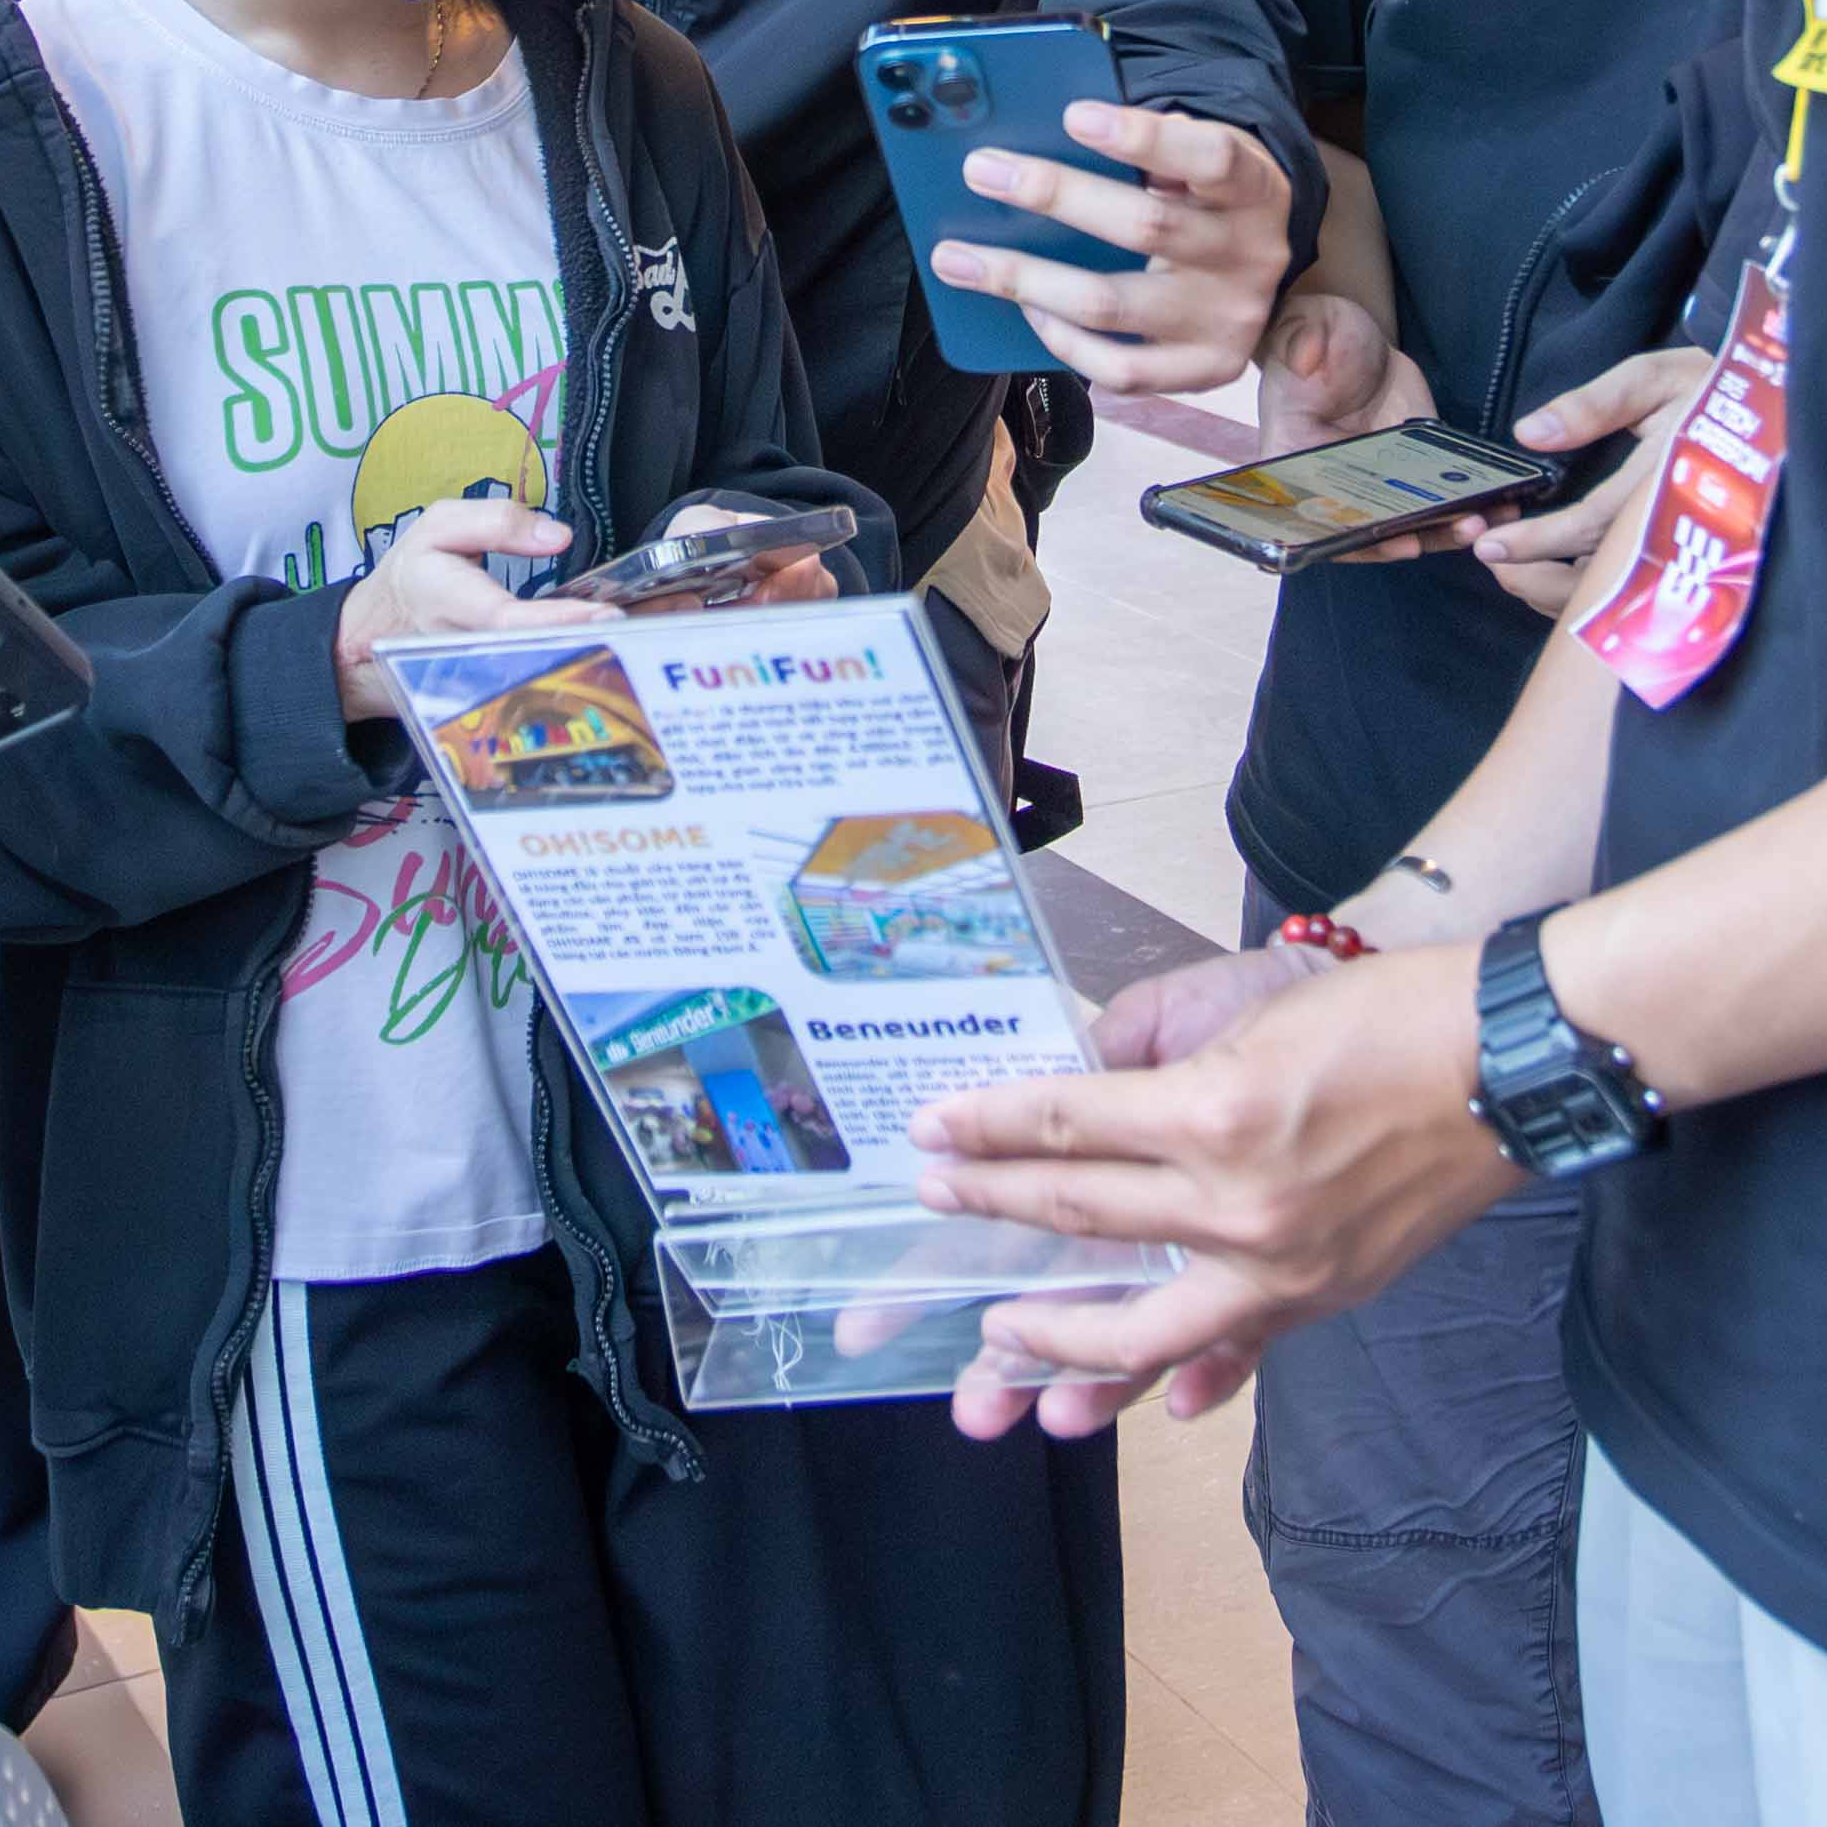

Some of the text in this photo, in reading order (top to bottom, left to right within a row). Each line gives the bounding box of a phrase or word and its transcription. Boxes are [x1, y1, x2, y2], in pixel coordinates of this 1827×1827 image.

[212, 280, 568, 473] SUMM
[661, 648, 885, 692] FuniFun!
[806, 1013, 1021, 1041] Beneunder
